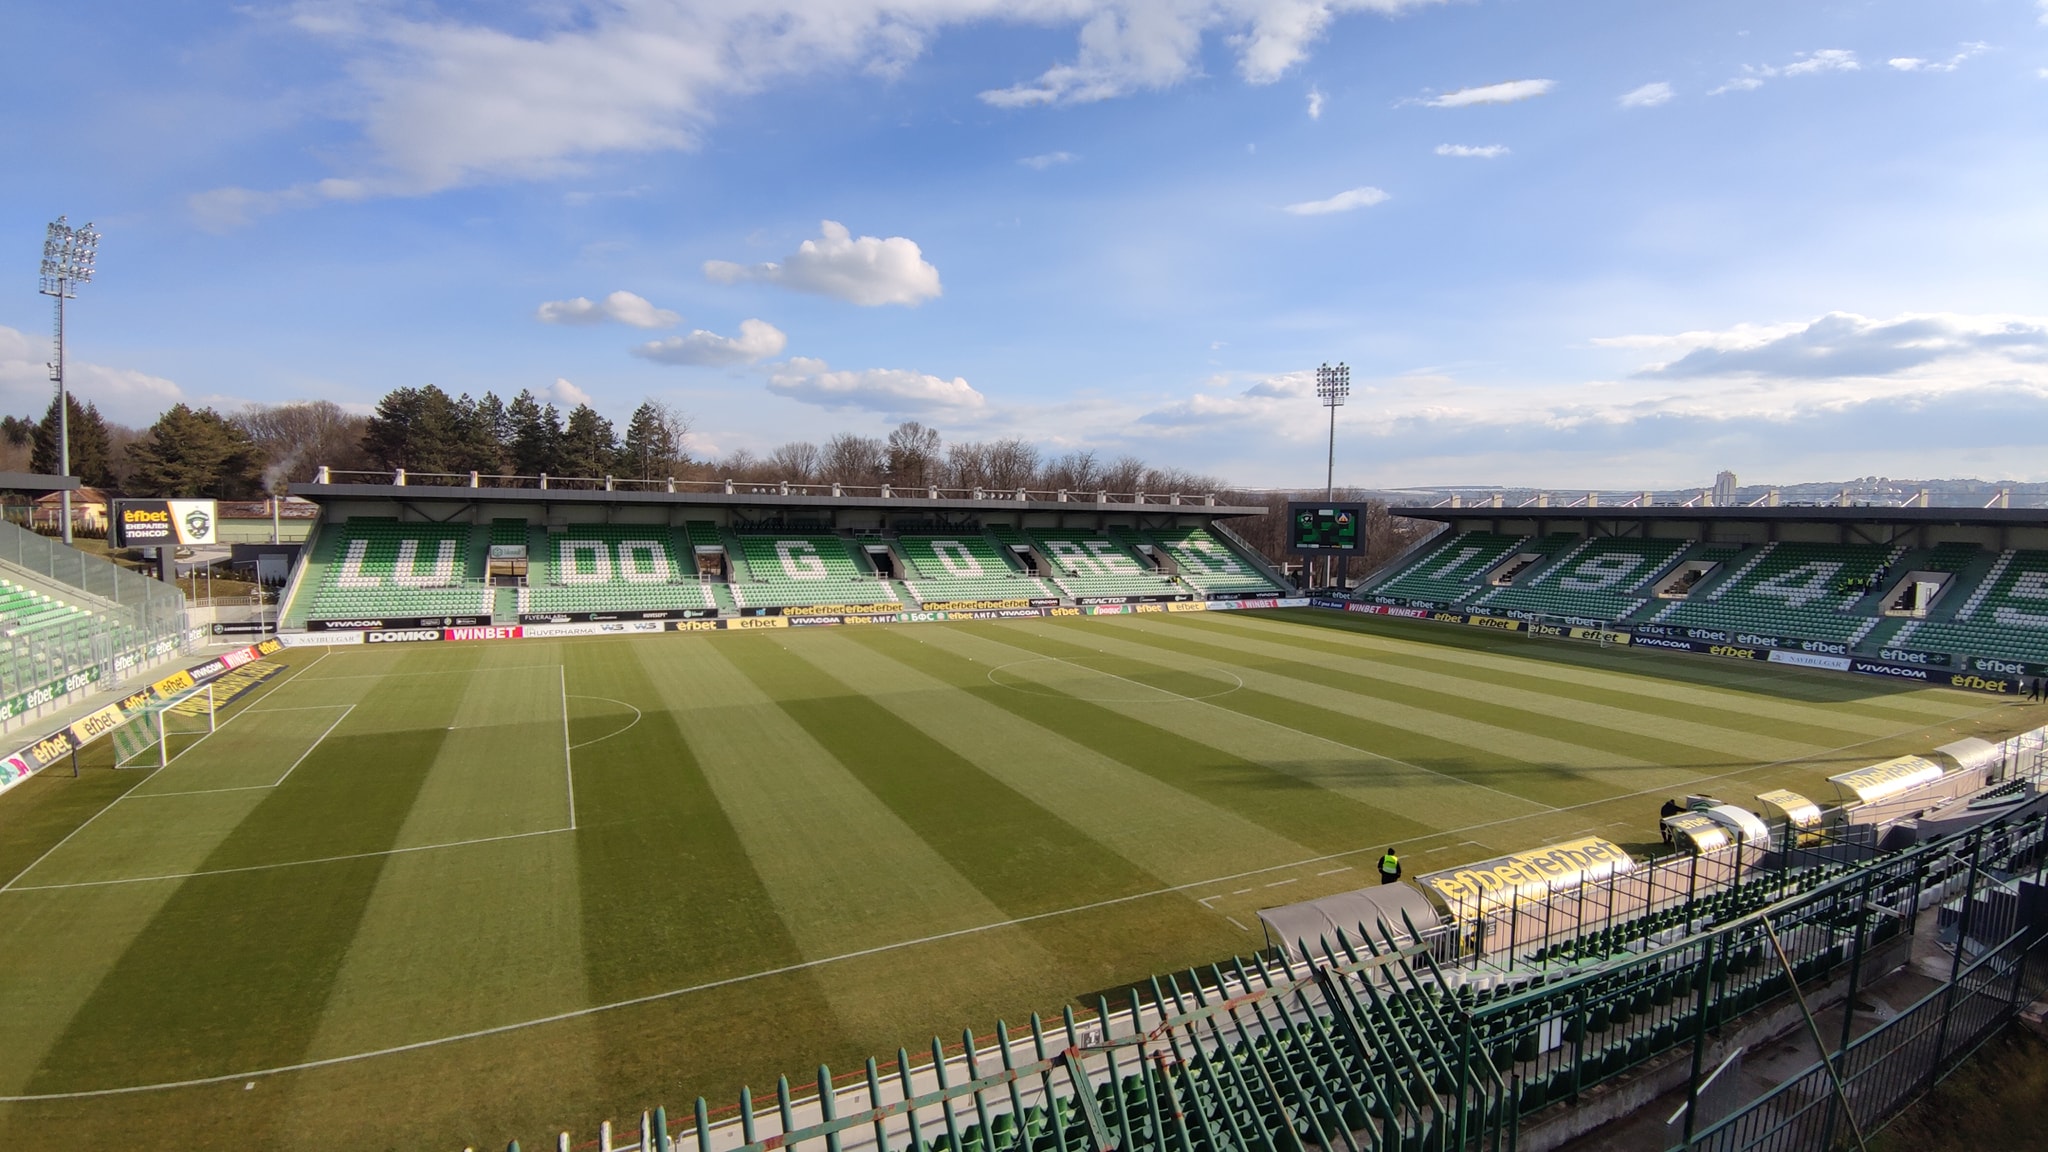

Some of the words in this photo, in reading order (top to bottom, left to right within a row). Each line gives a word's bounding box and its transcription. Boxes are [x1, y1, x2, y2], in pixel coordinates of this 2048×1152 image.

[124, 510, 168, 522] efbet
[951, 601, 977, 609] efbet
[978, 600, 1003, 609] efbet
[1004, 599, 1028, 608] efbet
[1245, 600, 1274, 609] WINBET
[1375, 596, 1396, 605] efbet
[1411, 600, 1434, 609] efbet
[783, 606, 814, 615] efbet
[815, 605, 844, 614] efbet
[845, 604, 875, 613] efbet
[876, 602, 903, 612] efbet
[923, 602, 950, 611] efbet
[1051, 607, 1080, 616] efbet
[1136, 604, 1162, 613] efbet
[1176, 603, 1200, 611] efbet
[1349, 603, 1381, 614] WINBET
[1465, 605, 1491, 616] efbet
[911, 612, 935, 621] БФС
[950, 611, 974, 620] efbet
[1388, 607, 1423, 618] WINBET
[1434, 613, 1463, 623] efbet
[325, 619, 383, 628] VIVACOM
[741, 618, 777, 628] efbet
[791, 617, 841, 625] VIVACOM
[844, 615, 872, 624] efbet
[1478, 617, 1509, 629] efbet
[676, 621, 717, 631] efbet
[368, 630, 440, 642] DOMKO
[453, 627, 516, 640] WINBET
[1687, 628, 1725, 640] efbet
[299, 635, 355, 644] NAVIBULGAR
[1635, 637, 1691, 649] VIVACOM
[1736, 632, 1778, 647] efbet
[1709, 645, 1756, 658] efbet
[1801, 640, 1846, 654] efbet
[1789, 655, 1843, 668] NAVIBULGAR
[1880, 648, 1927, 664] efbet
[1856, 663, 1927, 679] VIVACOM
[1975, 657, 2025, 675] efbet
[66, 671, 90, 691] efbet
[163, 678, 188, 695] efbet
[1951, 673, 2008, 693] efbet
[27, 686, 54, 708] efbet
[84, 711, 117, 736] efbet
[32, 733, 72, 764] efbet
[1531, 839, 1620, 873] efbet
[1432, 856, 1534, 900] efbet
